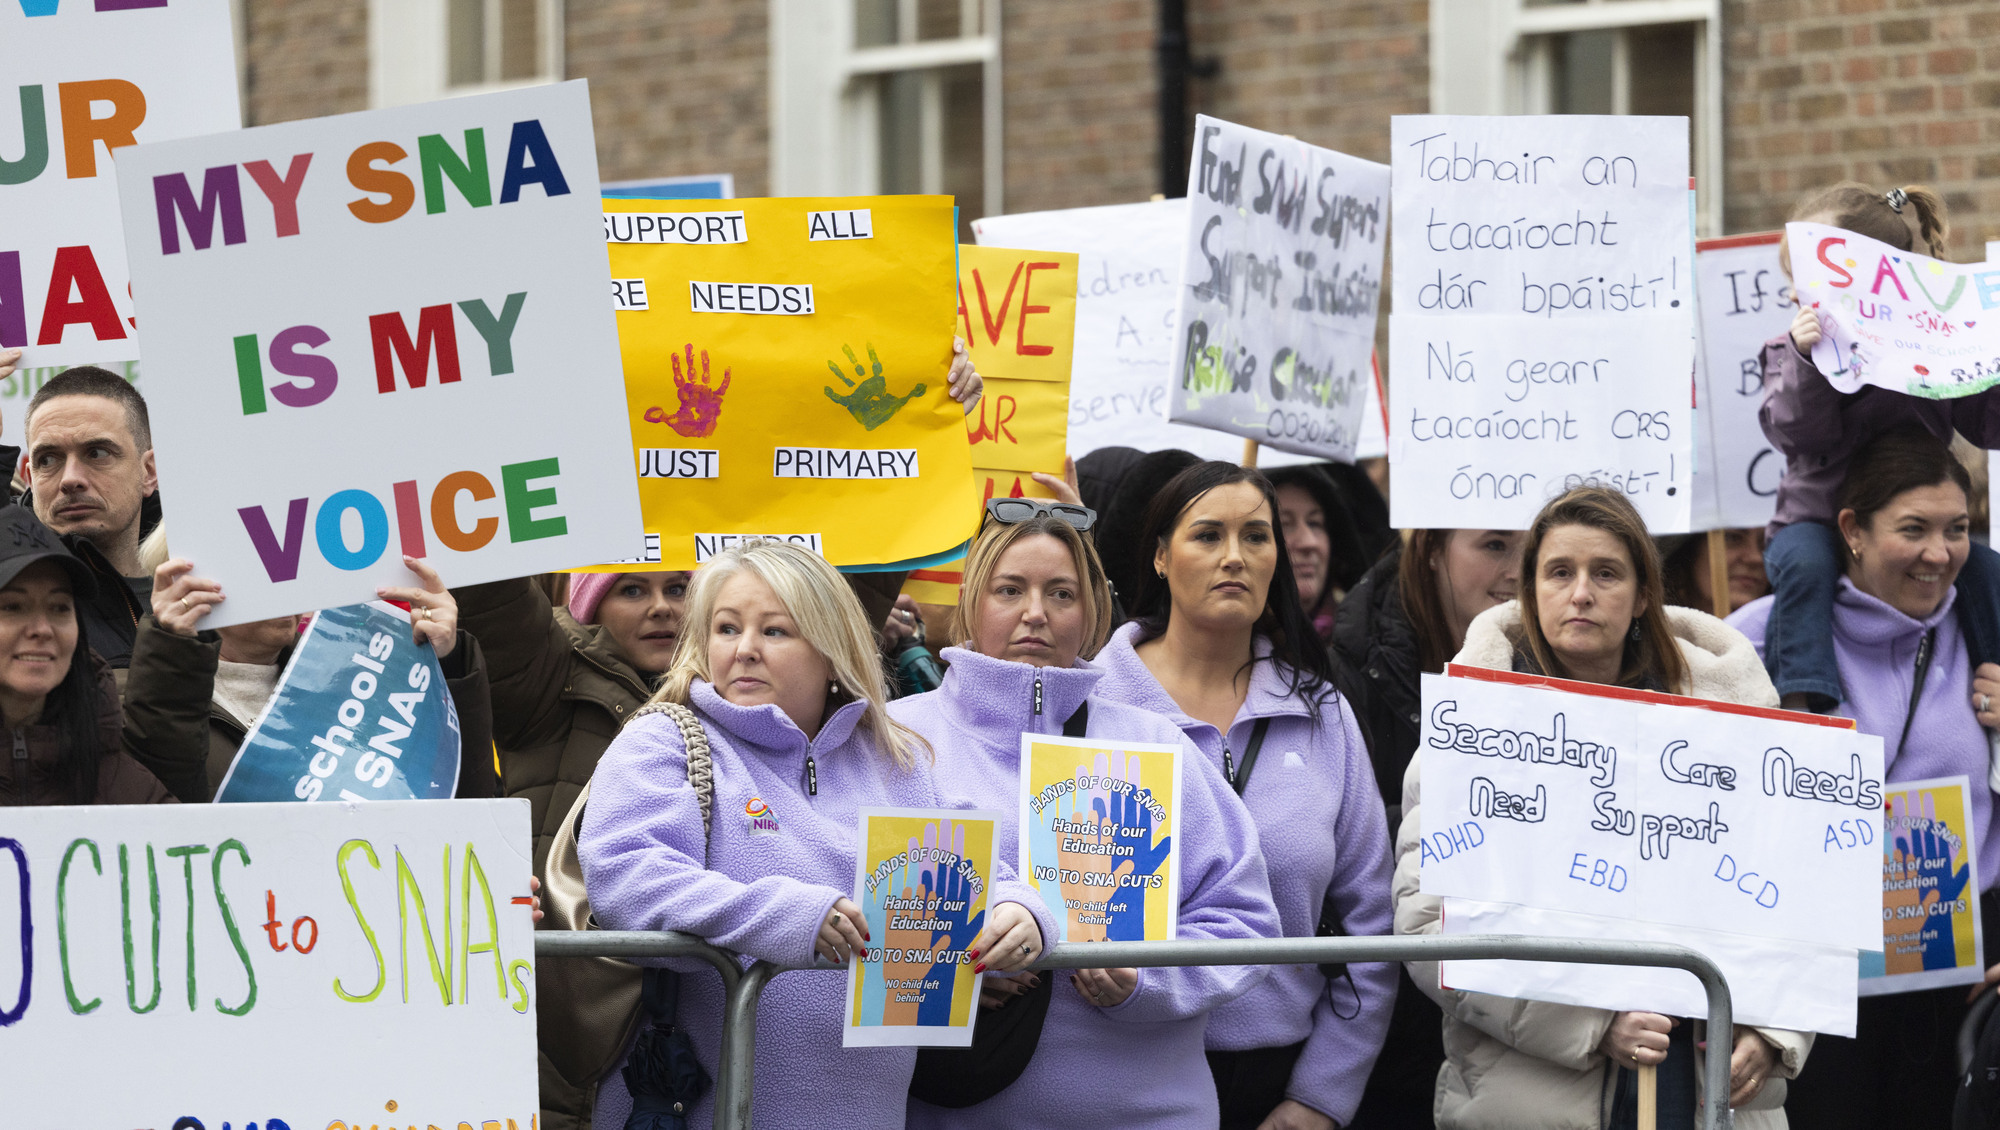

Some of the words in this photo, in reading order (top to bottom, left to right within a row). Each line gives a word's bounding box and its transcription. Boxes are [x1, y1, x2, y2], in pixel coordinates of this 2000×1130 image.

[1198, 126, 1246, 208] Fund
[1410, 133, 1555, 184] Tabhair
[1582, 155, 1637, 188] an
[153, 153, 314, 255] MY
[346, 119, 571, 224] SNA
[809, 212, 868, 239] ALL
[1427, 208, 1618, 251] tacaíocht
[1418, 269, 1487, 309] dár
[1522, 256, 1680, 318] bpáistí!
[1816, 236, 2000, 313] SAVE
[692, 283, 813, 313] NEEDS!
[1841, 293, 1893, 321] OUR
[233, 325, 339, 416] IS
[368, 291, 528, 394] MY
[1894, 338, 1922, 350] OUR
[1428, 341, 1475, 382] Ná
[1505, 358, 1609, 402] gearr
[1411, 408, 1578, 441] tacaíocht
[1611, 409, 1671, 441] CRS
[641, 450, 717, 478] JUST
[775, 449, 917, 478] PRIMARY
[1450, 464, 1536, 499] ónar
[1563, 453, 1677, 498] pástí!
[237, 457, 568, 583] VOICE
[294, 632, 394, 801] schools
[354, 662, 431, 788] SNAs
[1429, 700, 1617, 788] Secondary
[1661, 739, 1736, 791] Care
[1762, 747, 1882, 810] Needs
[1030, 778, 1076, 814] HANDS
[1078, 775, 1099, 790] OF
[1101, 777, 1133, 796] OUR
[1052, 817, 1098, 836] Hands
[1101, 823, 1120, 837] of
[1120, 827, 1147, 838] our
[1470, 776, 1546, 823] Need
[1590, 791, 1728, 860] Support
[1824, 818, 1874, 853] ASD
[1901, 816, 1930, 832] OUR
[1062, 838, 1135, 857] Education
[1420, 821, 1484, 868] ADHD
[865, 852, 908, 893] HANDS
[910, 847, 928, 863] OF
[930, 849, 958, 868] OUR
[1034, 865, 1057, 881] NO
[1060, 868, 1080, 884] TO
[1083, 871, 1116, 887] SNA
[1119, 873, 1163, 889] CUTS
[1568, 852, 1627, 892] EBD
[1714, 854, 1779, 908] DCD
[1907, 858, 1921, 872] of
[1924, 857, 1946, 870] our
[883, 895, 924, 911] Hands
[926, 896, 941, 911] of
[943, 900, 966, 912] our
[1065, 898, 1081, 909] NO
[1082, 900, 1107, 912] child
[1109, 901, 1127, 912] left
[1078, 913, 1113, 925] behind
[1896, 905, 1925, 919] SNA
[1929, 899, 1967, 914] CUTS
[57, 838, 258, 1017] CUTS
[261, 889, 318, 955] to
[889, 916, 953, 931] Education
[1923, 930, 1938, 941] left
[862, 948, 881, 963] NO
[884, 949, 902, 963] TO
[904, 949, 932, 964] SNA
[935, 950, 972, 964] CUTS
[885, 979, 900, 989] NO
[901, 979, 923, 990] child
[924, 979, 939, 990] left
[895, 992, 926, 1003] behind
